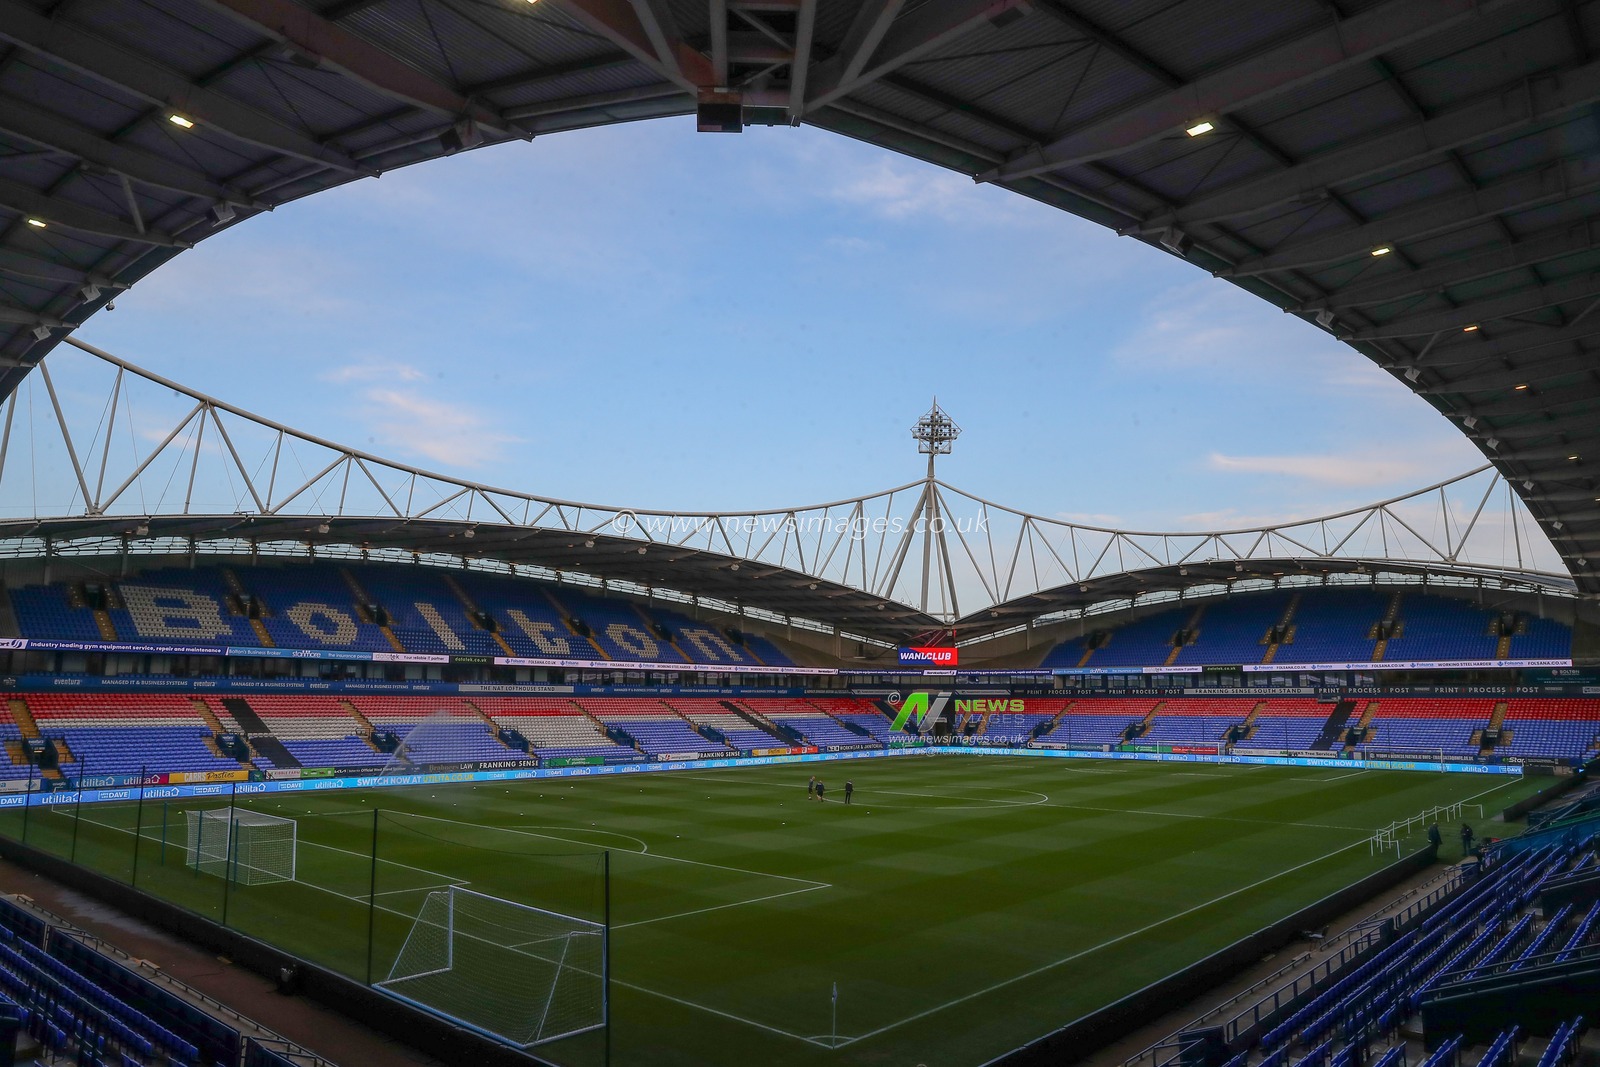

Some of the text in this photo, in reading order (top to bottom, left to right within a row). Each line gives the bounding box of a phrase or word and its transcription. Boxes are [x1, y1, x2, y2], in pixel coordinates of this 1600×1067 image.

[119, 585, 744, 662] Bolton
[76, 778, 105, 787] utilita
[357, 773, 474, 786] SWITCH NOW AT UTILITA.CO.UK
[234, 784, 259, 793] utilita
[144, 789, 170, 798] utilita
[42, 794, 72, 804] utilita
